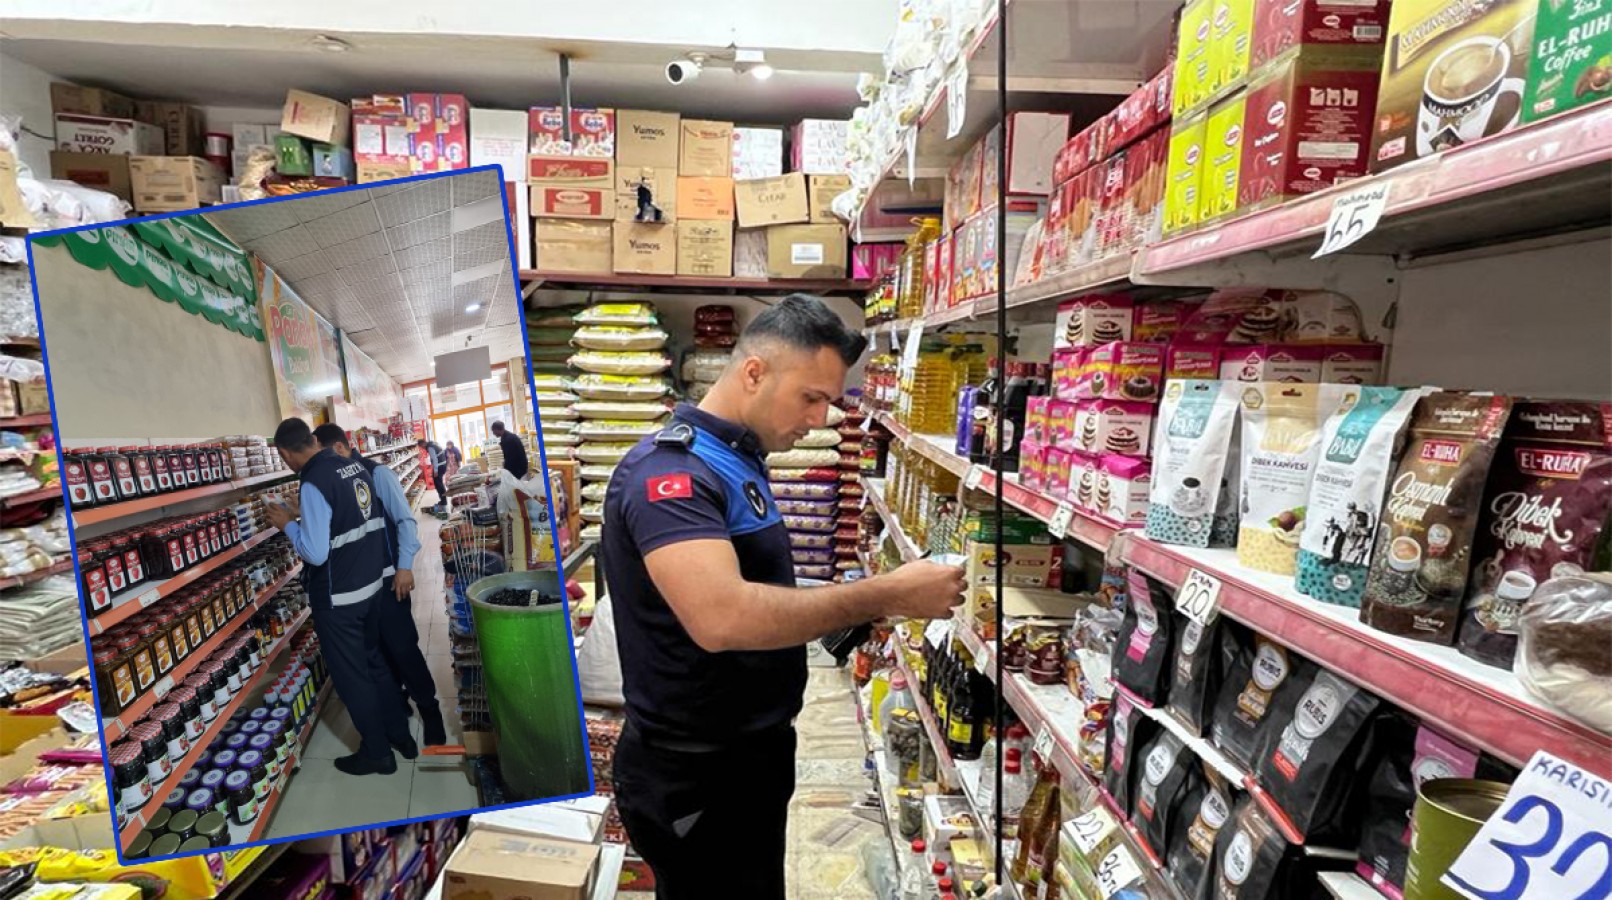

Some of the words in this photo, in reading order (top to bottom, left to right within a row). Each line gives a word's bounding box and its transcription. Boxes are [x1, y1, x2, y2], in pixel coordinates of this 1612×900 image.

[1544, 45, 1592, 72] Coffee
[1521, 452, 1580, 472] EL-RUHA
[1051, 556, 1063, 569] 2
[1180, 582, 1210, 617] 20
